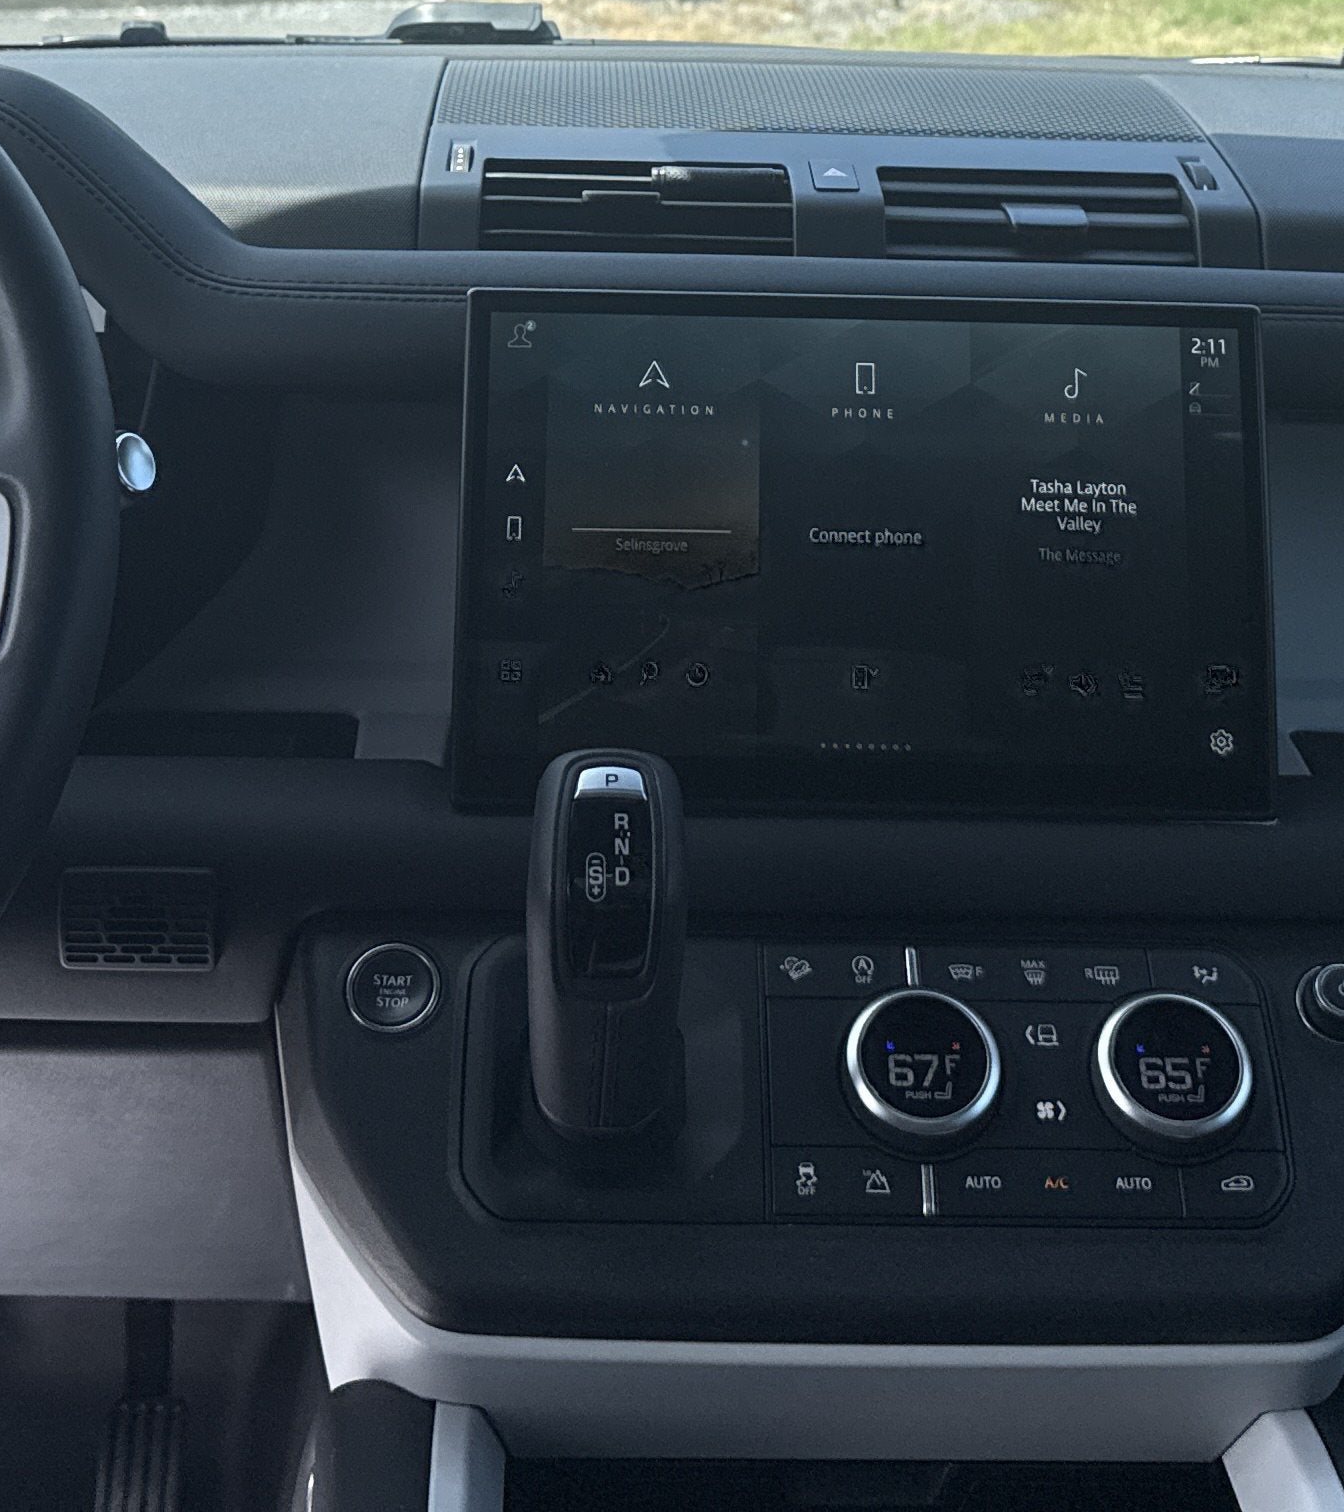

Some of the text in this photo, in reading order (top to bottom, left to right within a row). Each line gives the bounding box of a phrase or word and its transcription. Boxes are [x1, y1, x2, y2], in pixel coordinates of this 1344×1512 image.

[1191, 337, 1226, 355] 2:11
[1200, 356, 1220, 368] PM
[594, 403, 715, 416] NAVIGATION
[831, 408, 894, 419] PHONE
[1044, 412, 1104, 424] MEDIA
[1030, 479, 1127, 497] Tasha Layton
[1021, 497, 1138, 515] Meet Me In The
[1057, 516, 1102, 534] Valley
[809, 527, 923, 547] Connect phone
[615, 538, 689, 554] Selinsgrove
[1038, 547, 1121, 565] The Message
[605, 773, 619, 787] P
[614, 813, 629, 830] R
[614, 838, 630, 855] N
[589, 865, 603, 885] S
[615, 867, 630, 886] D
[1020, 959, 1046, 969] MAX
[1084, 968, 1094, 978] R
[373, 974, 413, 987] START
[376, 996, 410, 1008] STOP
[905, 1090, 932, 1099] PUSH
[1158, 1093, 1186, 1103] PUSH
[965, 1176, 1002, 1189] AUTO
[1044, 1176, 1070, 1189] A/C
[1115, 1176, 1152, 1190] AUTO
